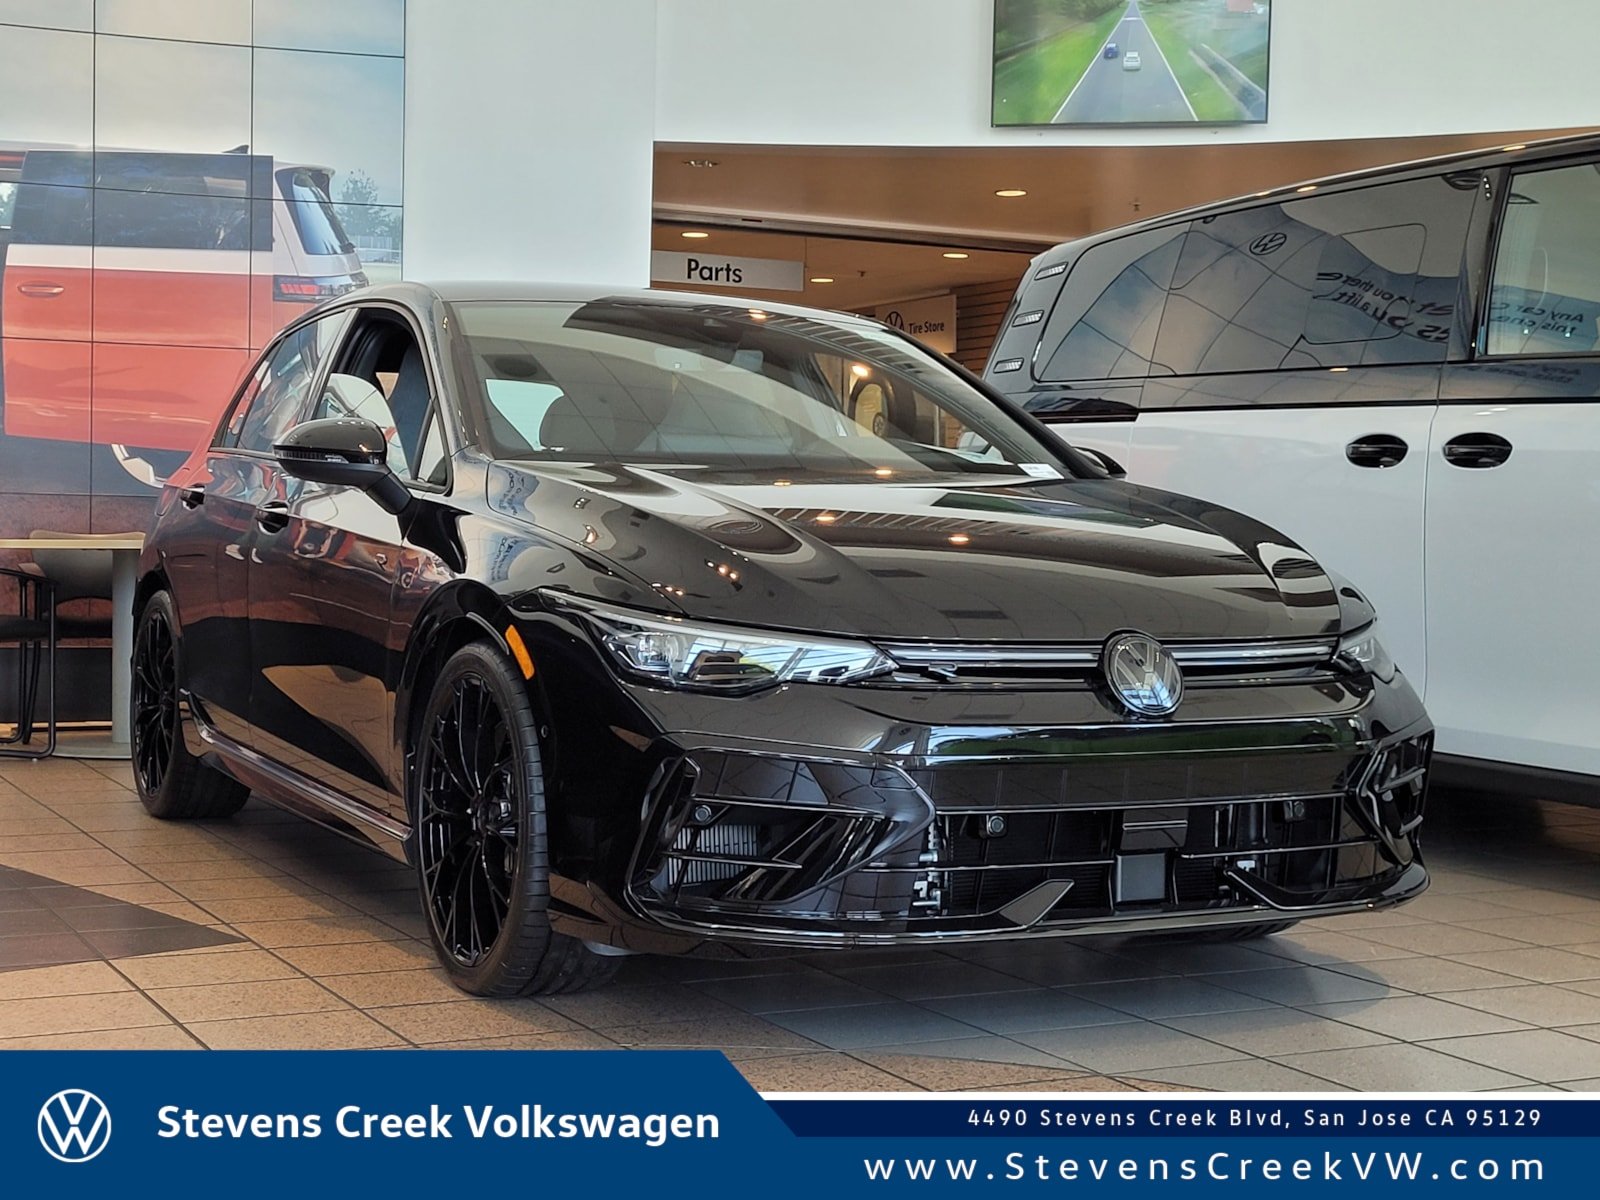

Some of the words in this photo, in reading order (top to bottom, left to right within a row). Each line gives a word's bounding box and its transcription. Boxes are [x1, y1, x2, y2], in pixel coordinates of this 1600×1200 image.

[687, 258, 743, 283] Parts
[909, 323, 923, 334] Tire
[924, 321, 945, 333] Store
